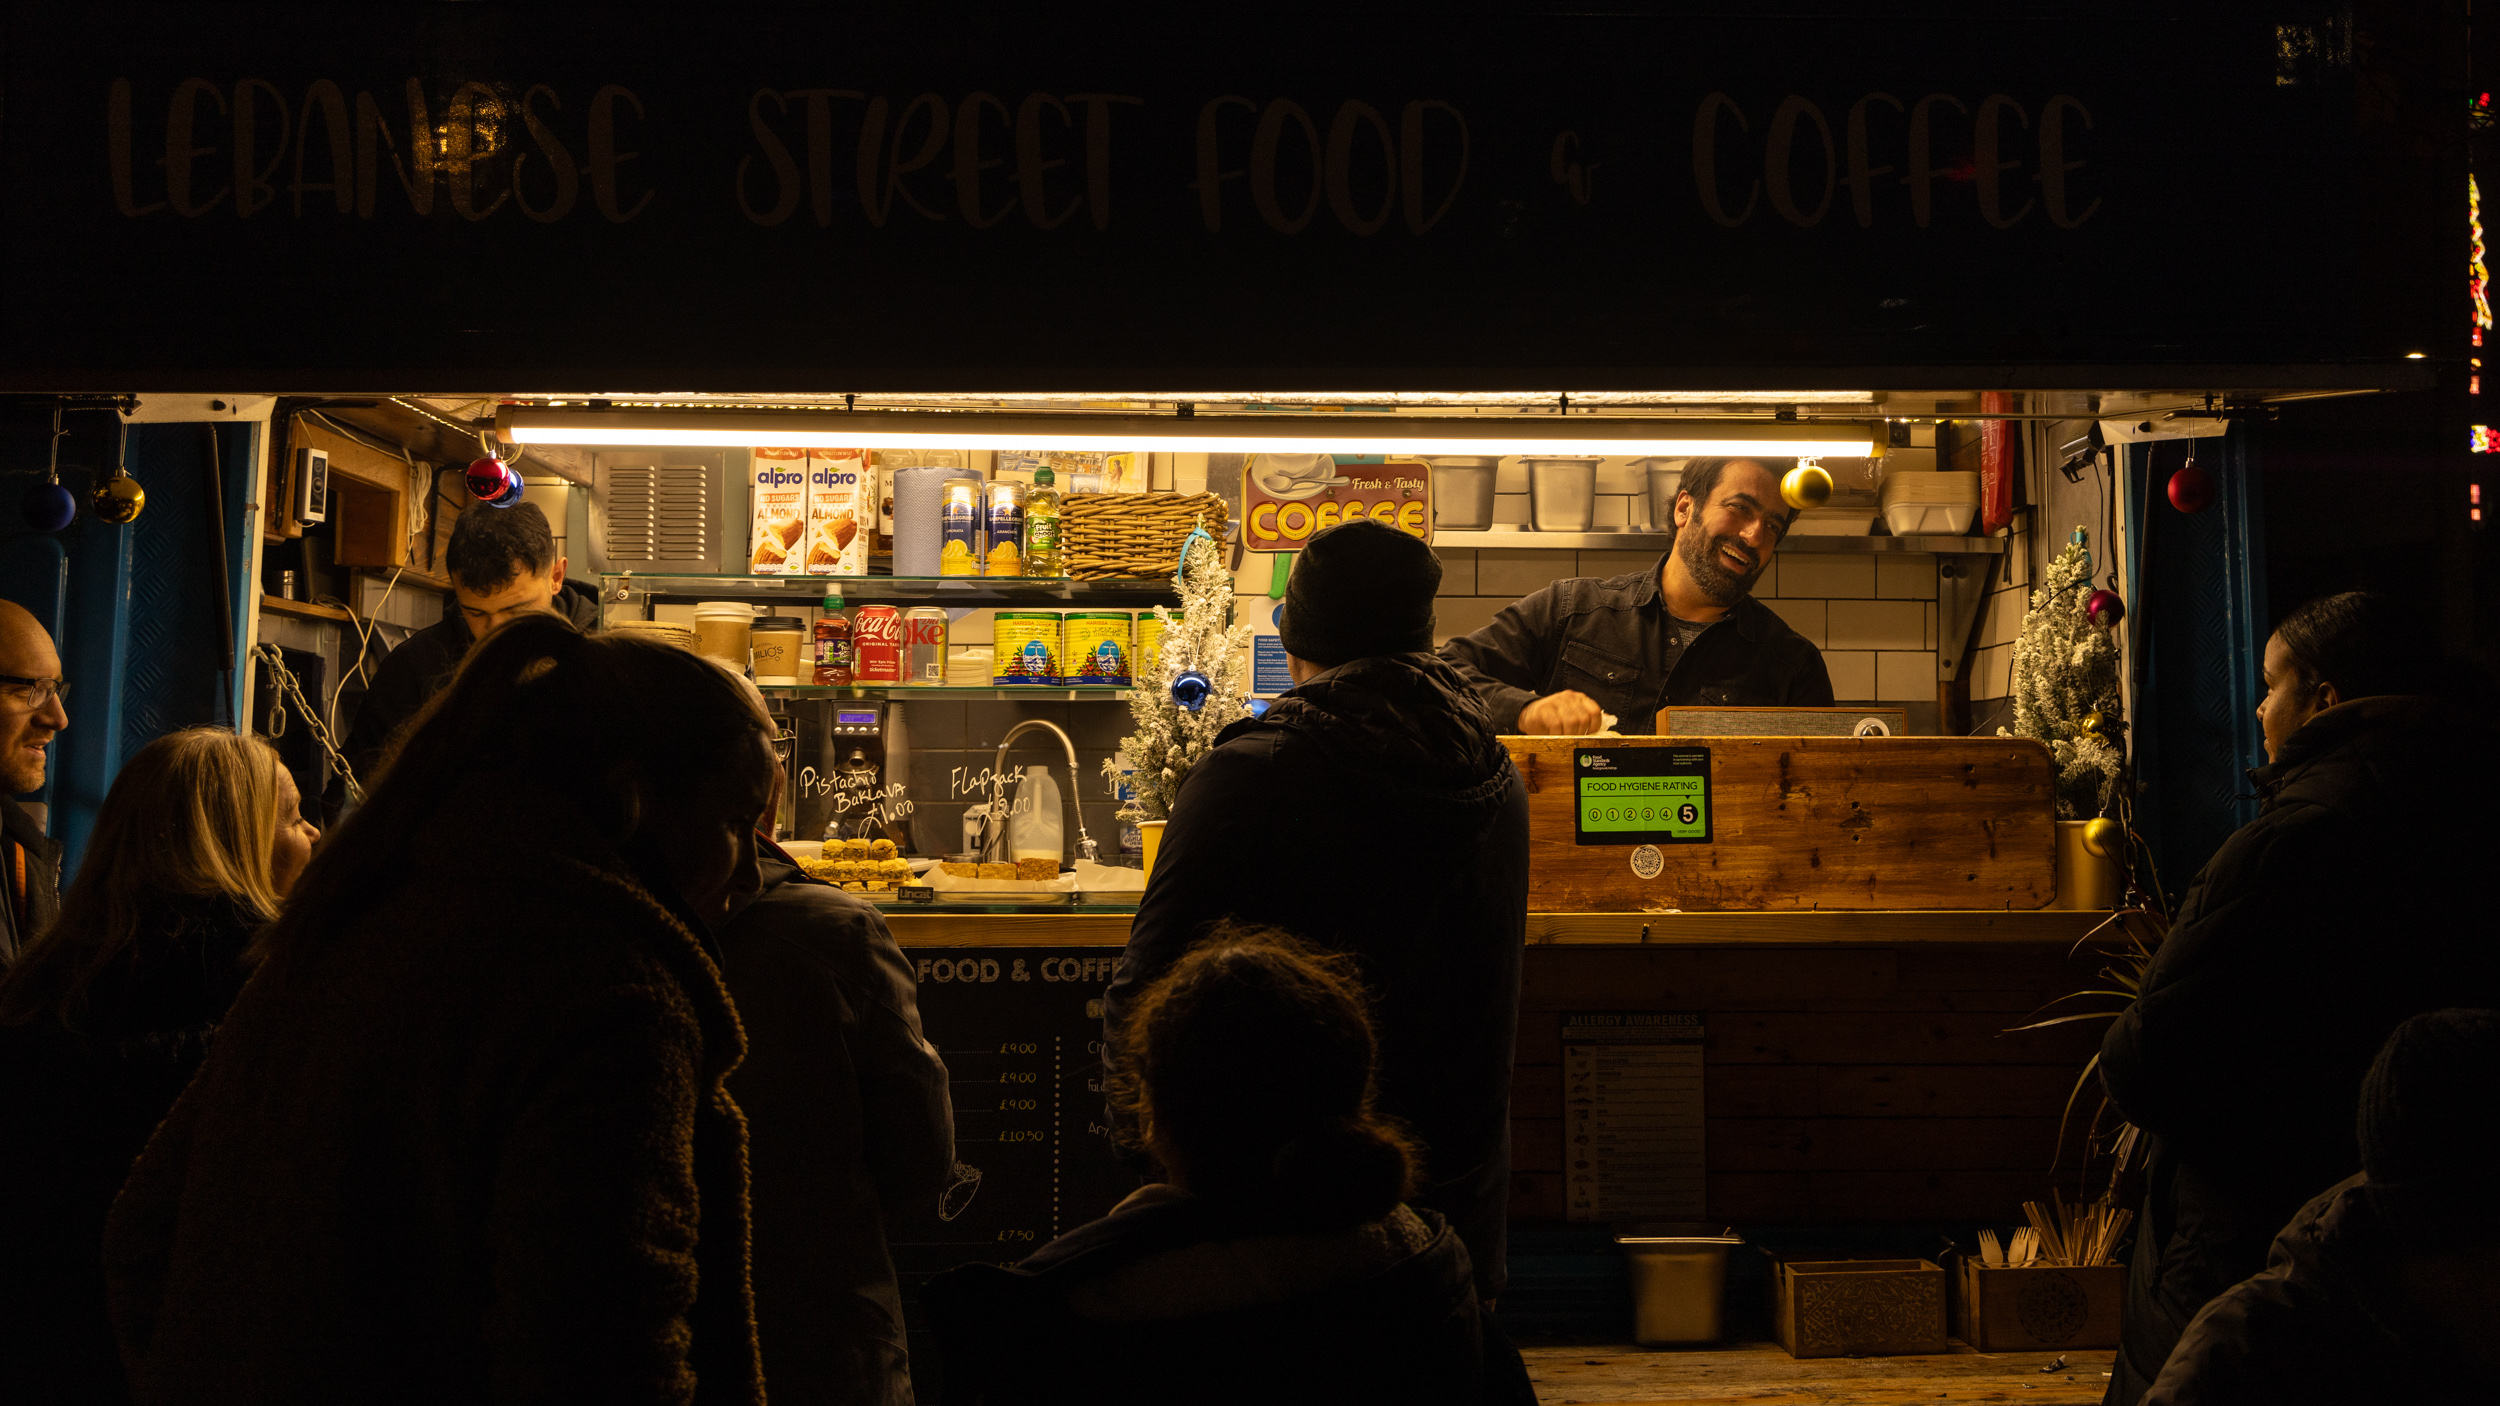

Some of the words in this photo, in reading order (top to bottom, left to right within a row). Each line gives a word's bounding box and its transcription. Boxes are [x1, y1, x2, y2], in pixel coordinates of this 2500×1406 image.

[108, 77, 655, 224] LEBANESE
[737, 87, 1144, 229] STREET
[1188, 94, 1469, 236] FOOD
[1692, 92, 2101, 228] COFFEE
[757, 467, 803, 488] alpro
[812, 467, 857, 488] alpro
[1352, 477, 1382, 490] Fresh
[1393, 476, 1425, 491] Tasty
[759, 494, 770, 503] NO
[771, 493, 800, 503] SUGARS
[814, 494, 824, 503] NO
[825, 493, 854, 503] SUGARS
[757, 508, 800, 520] ALMOND
[811, 508, 854, 520] ALMOND
[1035, 523, 1052, 531] Fruit
[854, 610, 901, 640] Coca-Co
[1587, 782, 1617, 792] FOOD
[1619, 782, 1661, 791] HYGIENE
[1663, 781, 1698, 790] RATING
[1682, 806, 1694, 823] 5
[917, 958, 1000, 984] FOOD
[1010, 958, 1031, 983] &
[1569, 1015, 1622, 1026] ALLERGY
[1625, 1014, 1698, 1026] AWARENESS
[999, 1130, 1044, 1142] £10.50
